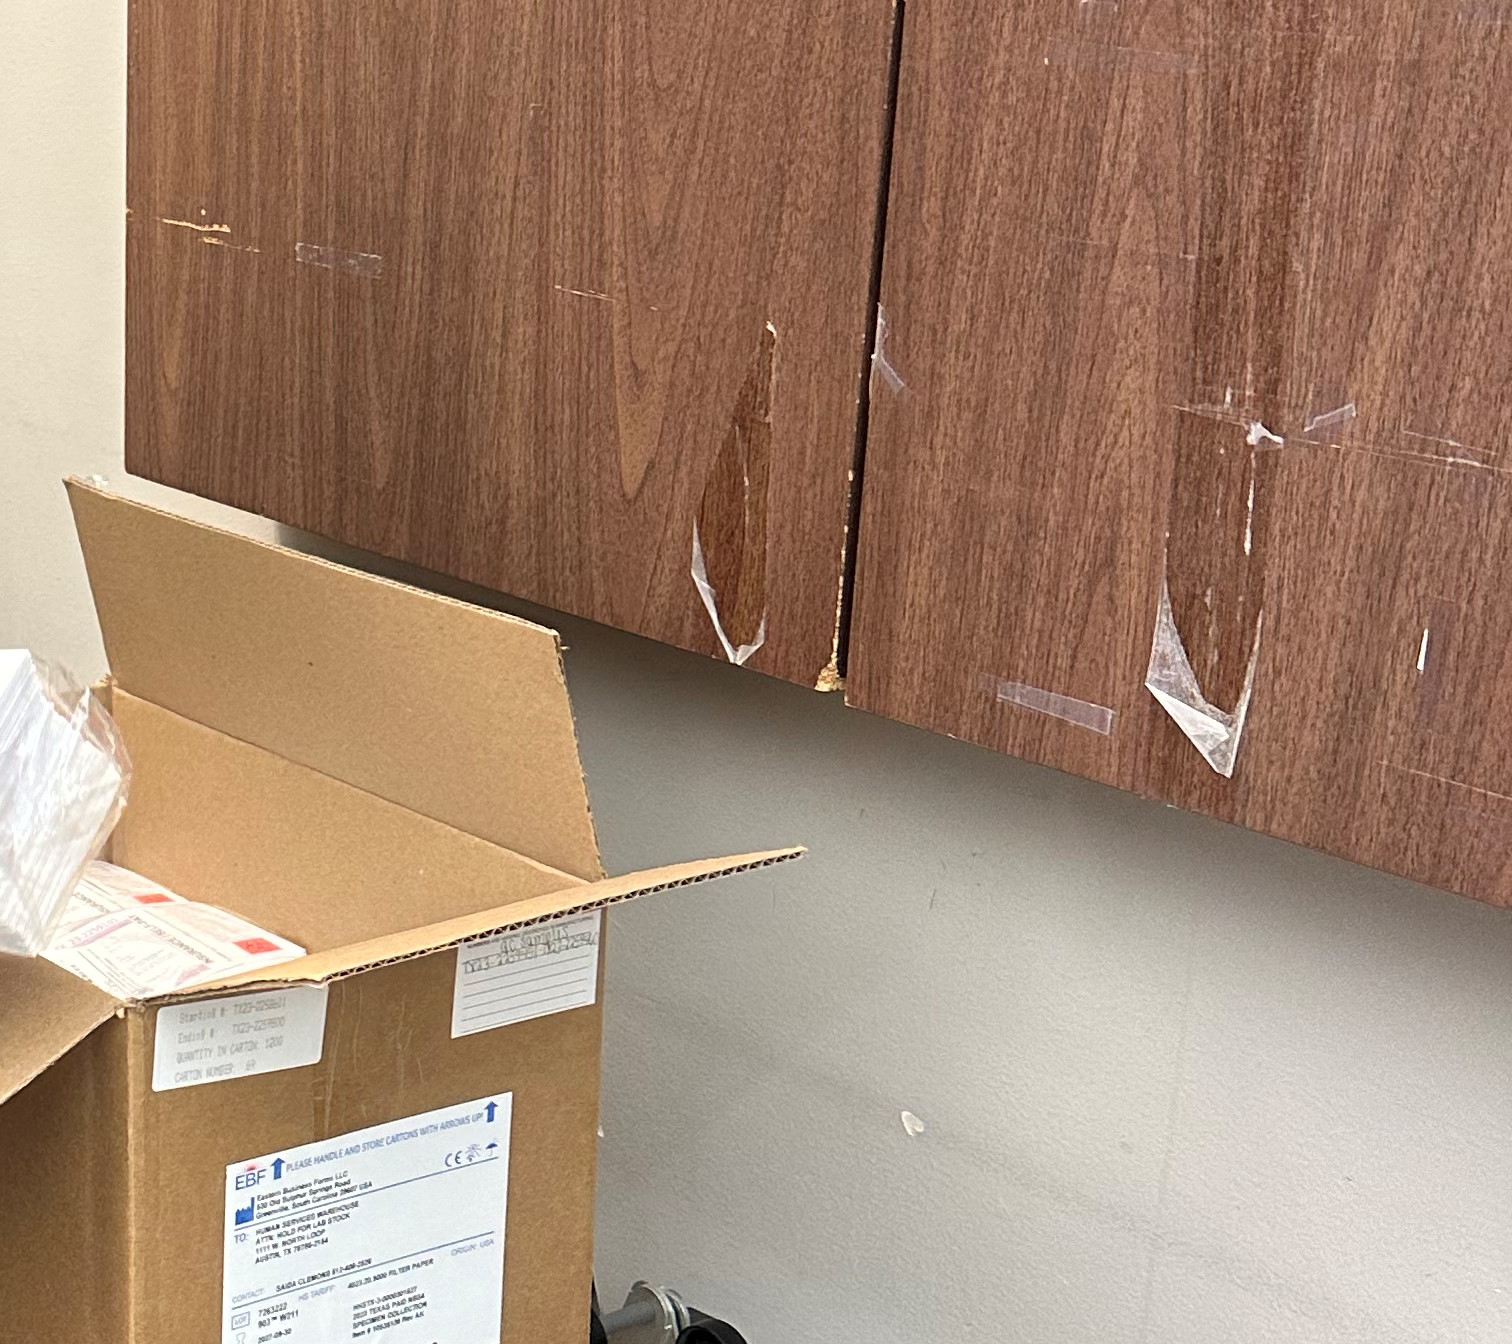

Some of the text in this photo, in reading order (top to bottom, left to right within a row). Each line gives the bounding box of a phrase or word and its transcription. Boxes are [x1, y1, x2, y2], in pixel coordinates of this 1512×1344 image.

[286, 1156, 313, 1172] PLEASE
[313, 1149, 344, 1165] HANDLE
[344, 1144, 361, 1156] AND
[361, 1138, 385, 1152] STORE
[386, 1129, 418, 1145] CARTONS
[419, 1124, 439, 1136] WITH
[440, 1116, 471, 1132] ARROWS
[235, 1169, 267, 1190] EBF
[412, 1258, 434, 1271] PAPER
